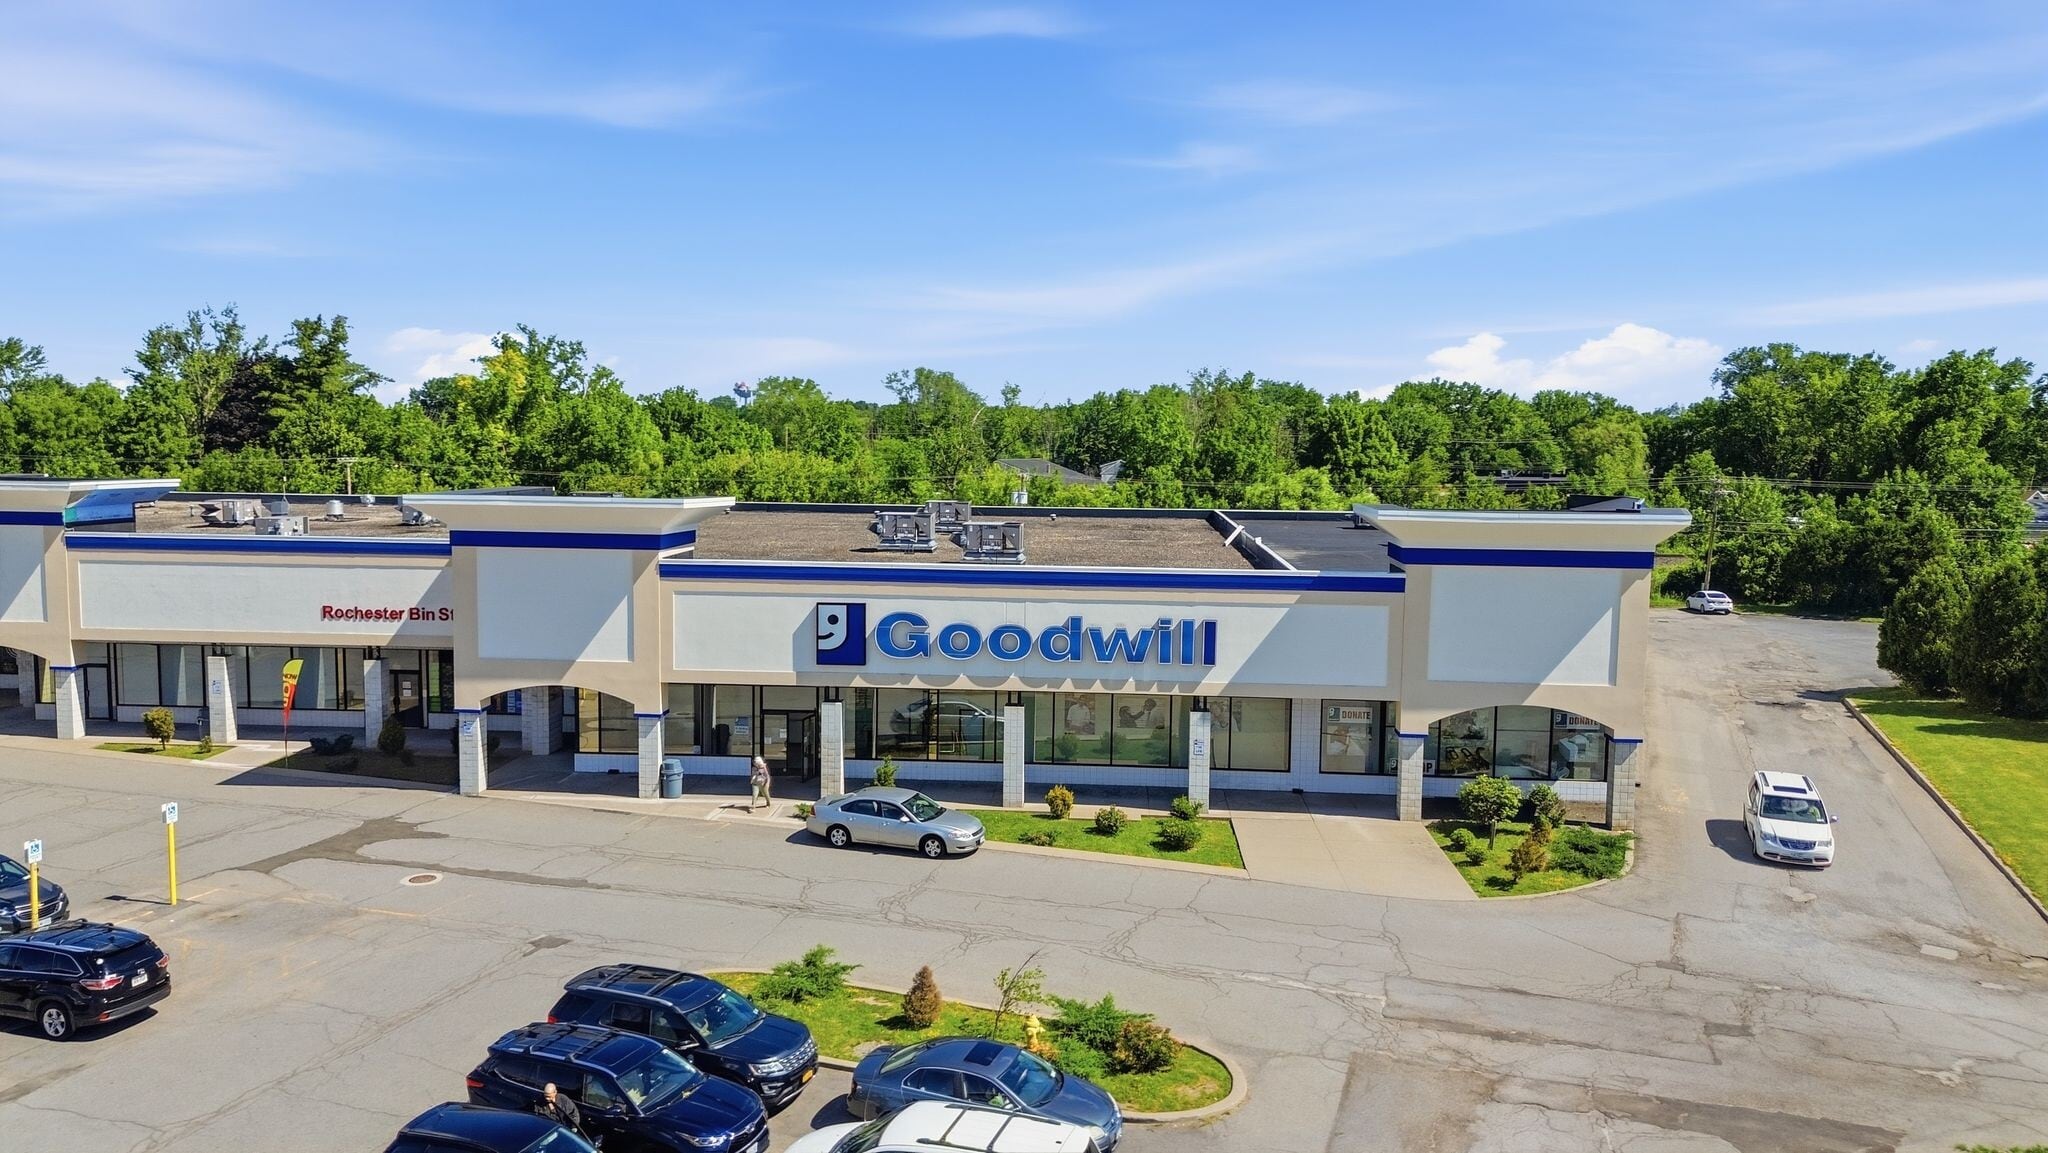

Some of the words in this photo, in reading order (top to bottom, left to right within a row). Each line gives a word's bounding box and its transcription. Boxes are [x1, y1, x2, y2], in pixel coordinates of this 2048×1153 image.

[322, 605, 405, 620] Rochester
[409, 607, 435, 621] Bin
[874, 611, 1218, 667] Goodwill
[1341, 710, 1371, 720] DONATE
